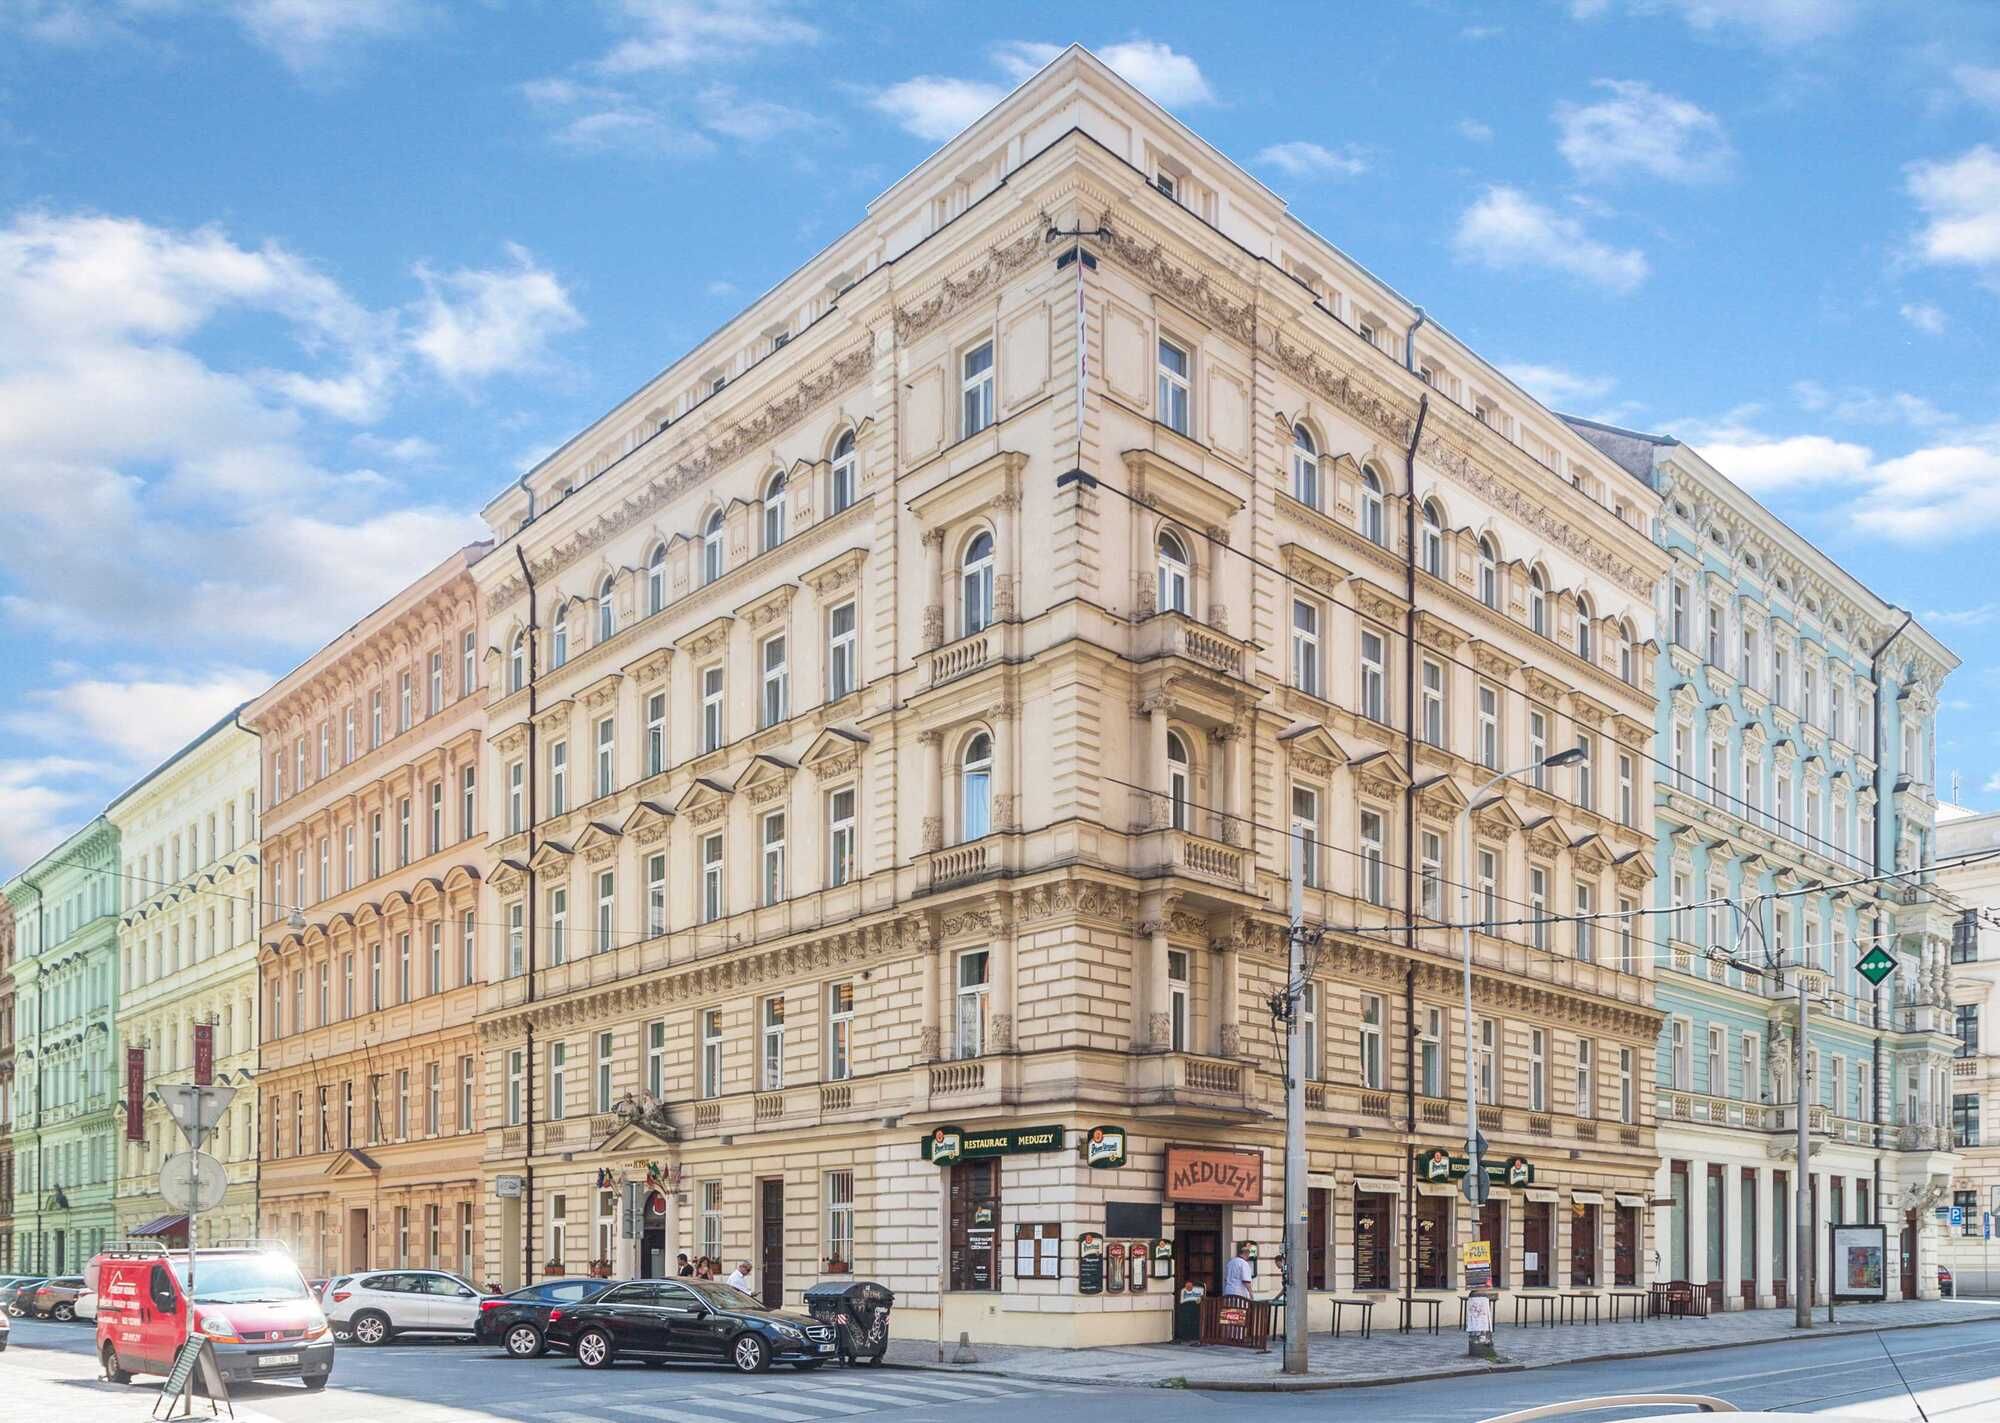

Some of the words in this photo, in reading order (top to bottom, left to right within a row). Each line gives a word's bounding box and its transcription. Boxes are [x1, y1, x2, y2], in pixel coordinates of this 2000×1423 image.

[964, 1137, 1008, 1150] RESTAURACE
[1018, 1134, 1054, 1146] MEDUZZY
[1173, 1160, 1257, 1198] MEDUZZY
[1952, 1209, 1960, 1220] P
